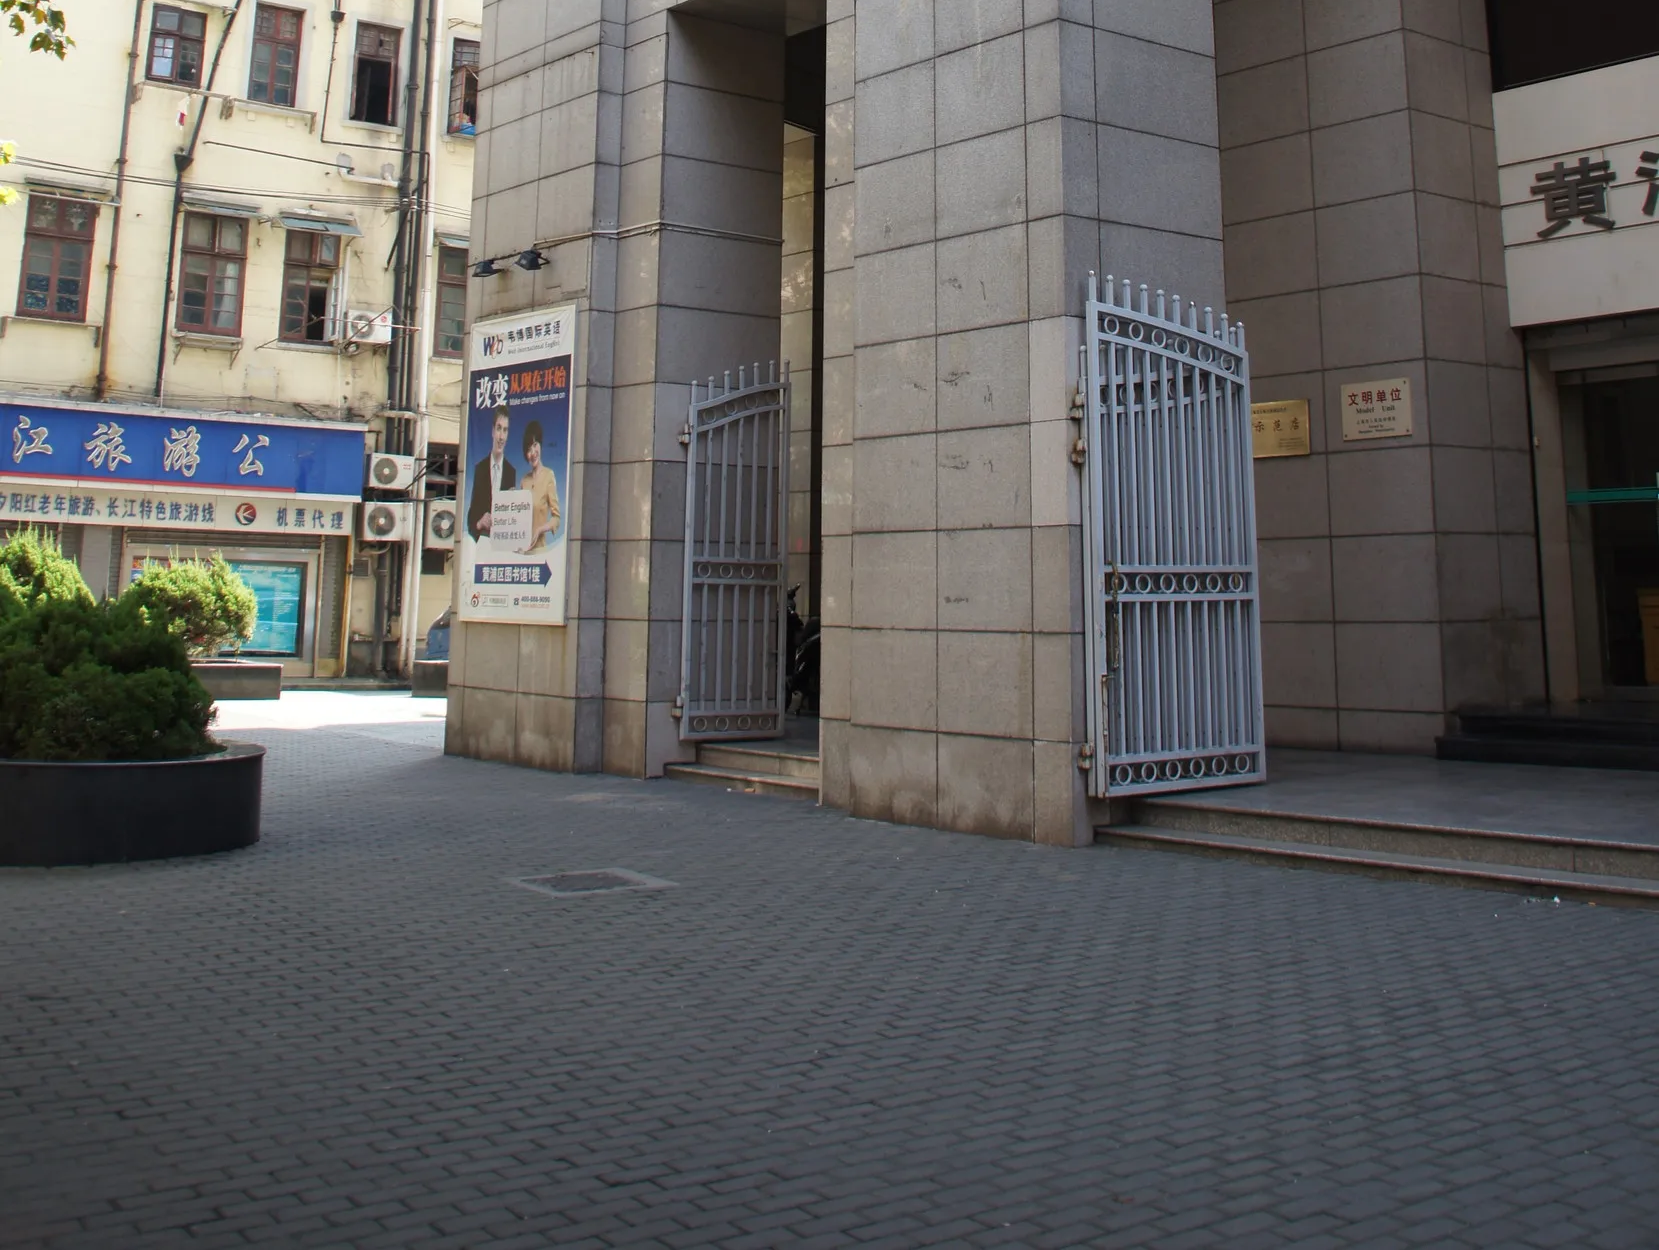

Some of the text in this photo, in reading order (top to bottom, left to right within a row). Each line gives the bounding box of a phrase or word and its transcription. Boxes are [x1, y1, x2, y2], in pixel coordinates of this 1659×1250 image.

[508, 320, 561, 344] 韦博国际英语
[483, 335, 503, 359] Web
[476, 365, 567, 410] 改变 从现在开始
[1347, 387, 1402, 407] 文明单位
[494, 502, 530, 513] Better English
[276, 507, 344, 530] 机票代理
[493, 517, 507, 526] Better
[481, 566, 541, 582] 黄浦区图书馆1楼
